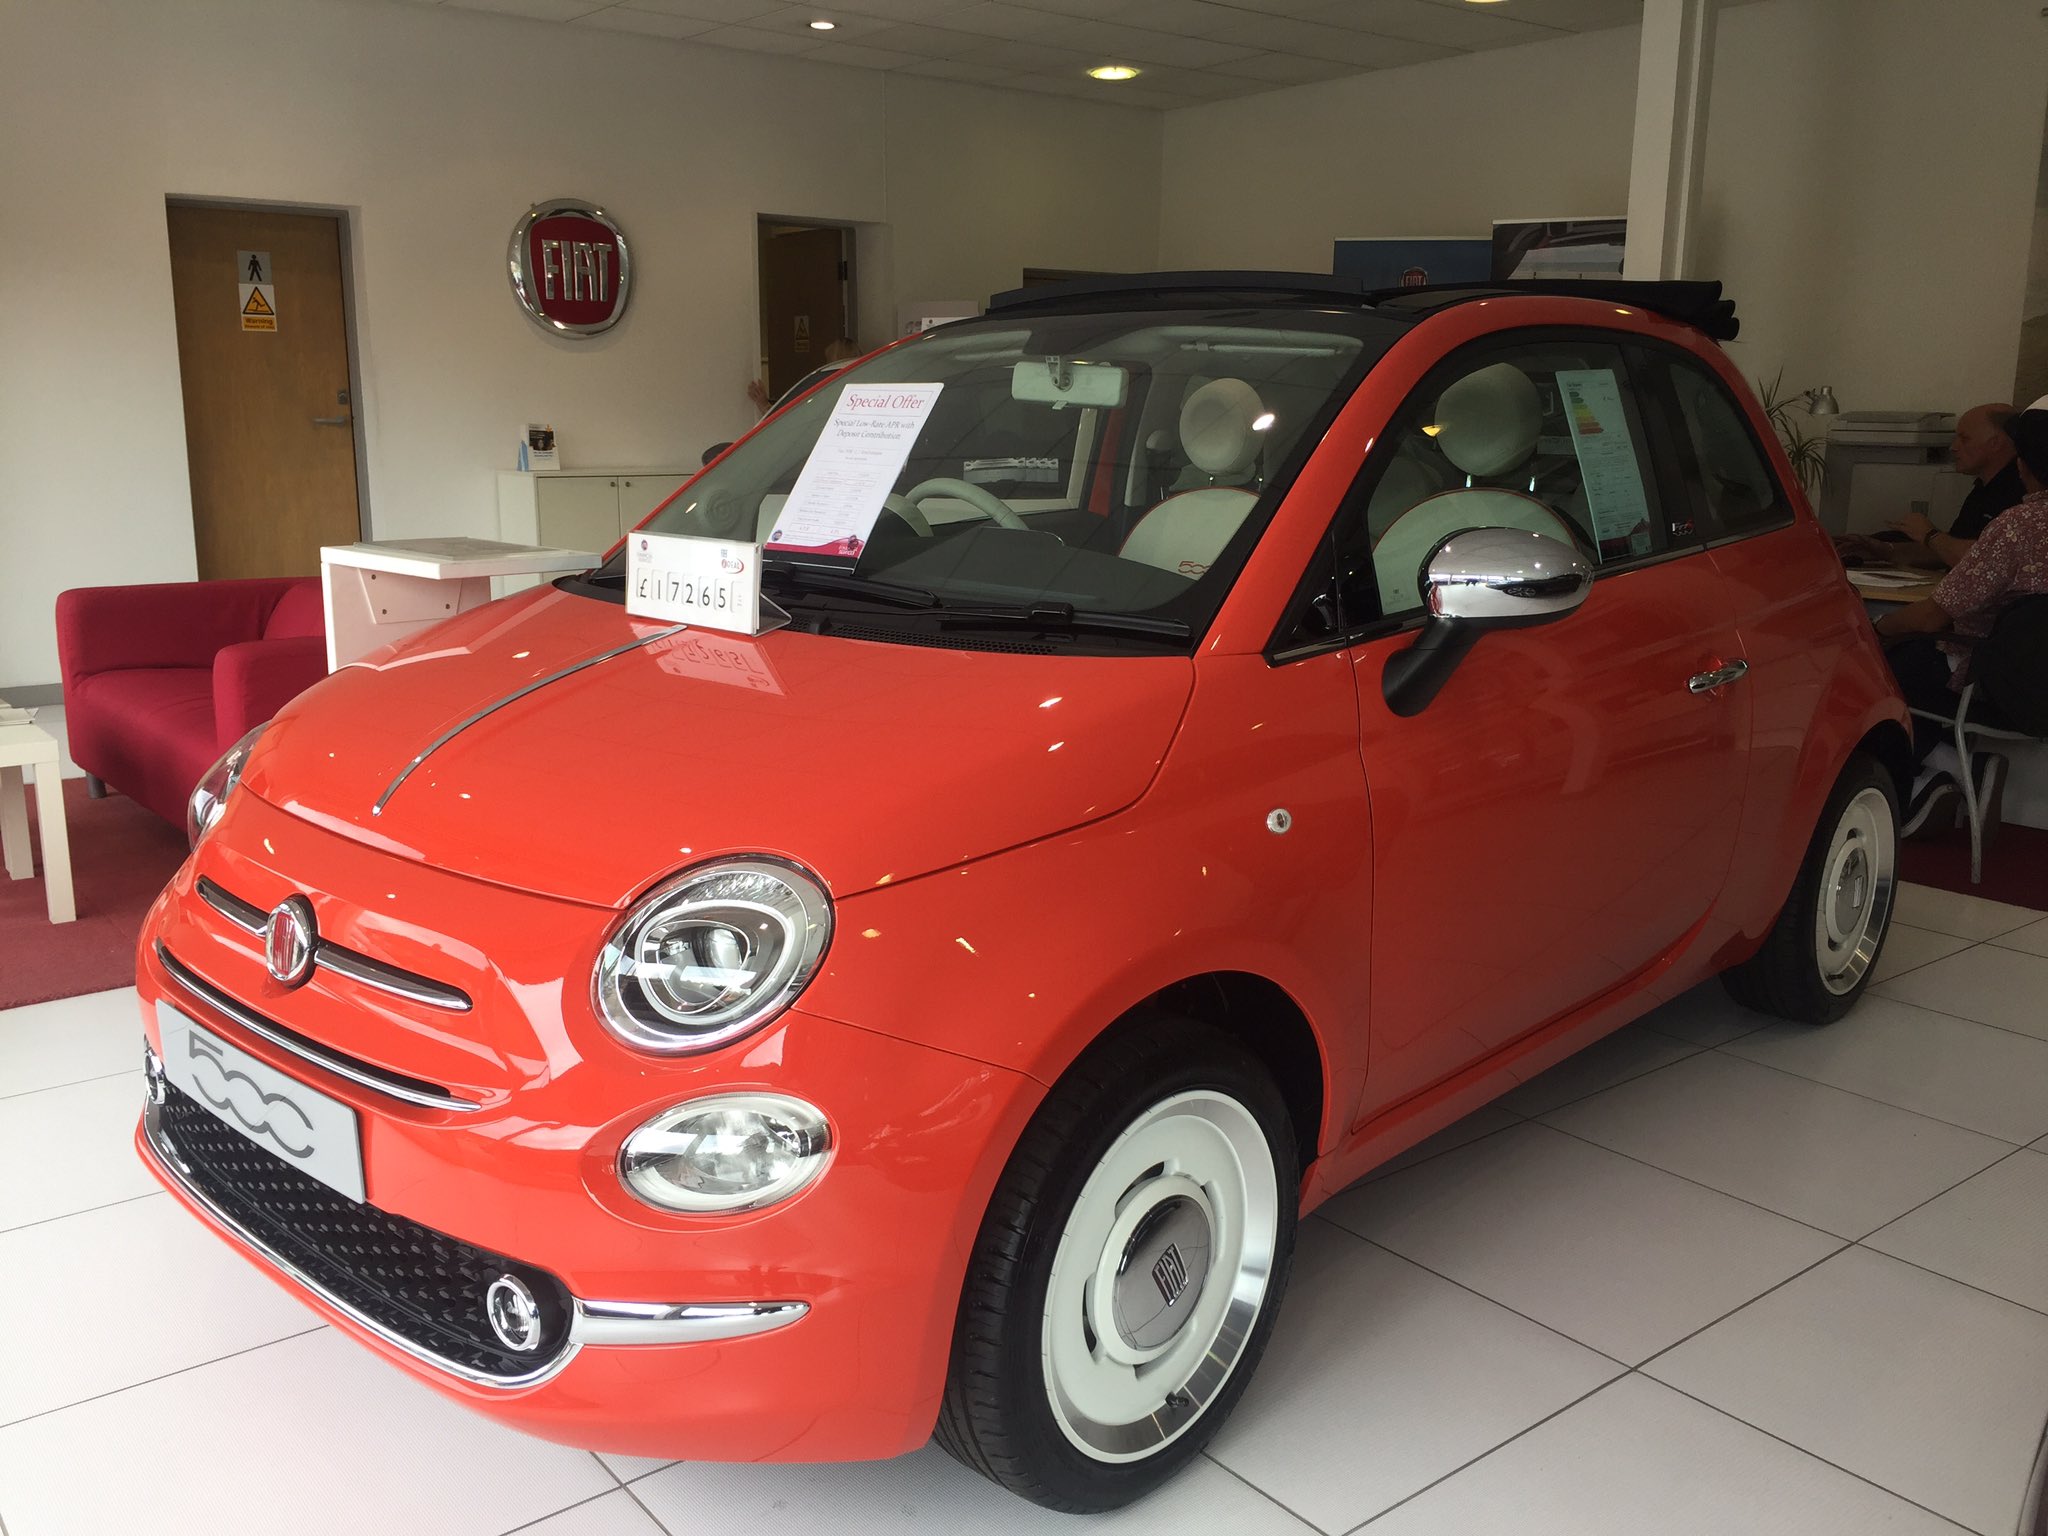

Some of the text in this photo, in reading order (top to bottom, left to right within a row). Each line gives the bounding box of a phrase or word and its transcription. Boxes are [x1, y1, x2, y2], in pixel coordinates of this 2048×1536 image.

[541, 238, 612, 302] FIAT
[1405, 275, 1424, 287] FIAT
[846, 393, 925, 411] Special Offer
[834, 418, 855, 428] Special
[639, 578, 726, 609] £17265
[189, 1029, 315, 1159] 500
[1154, 1245, 1186, 1303] FIAT
